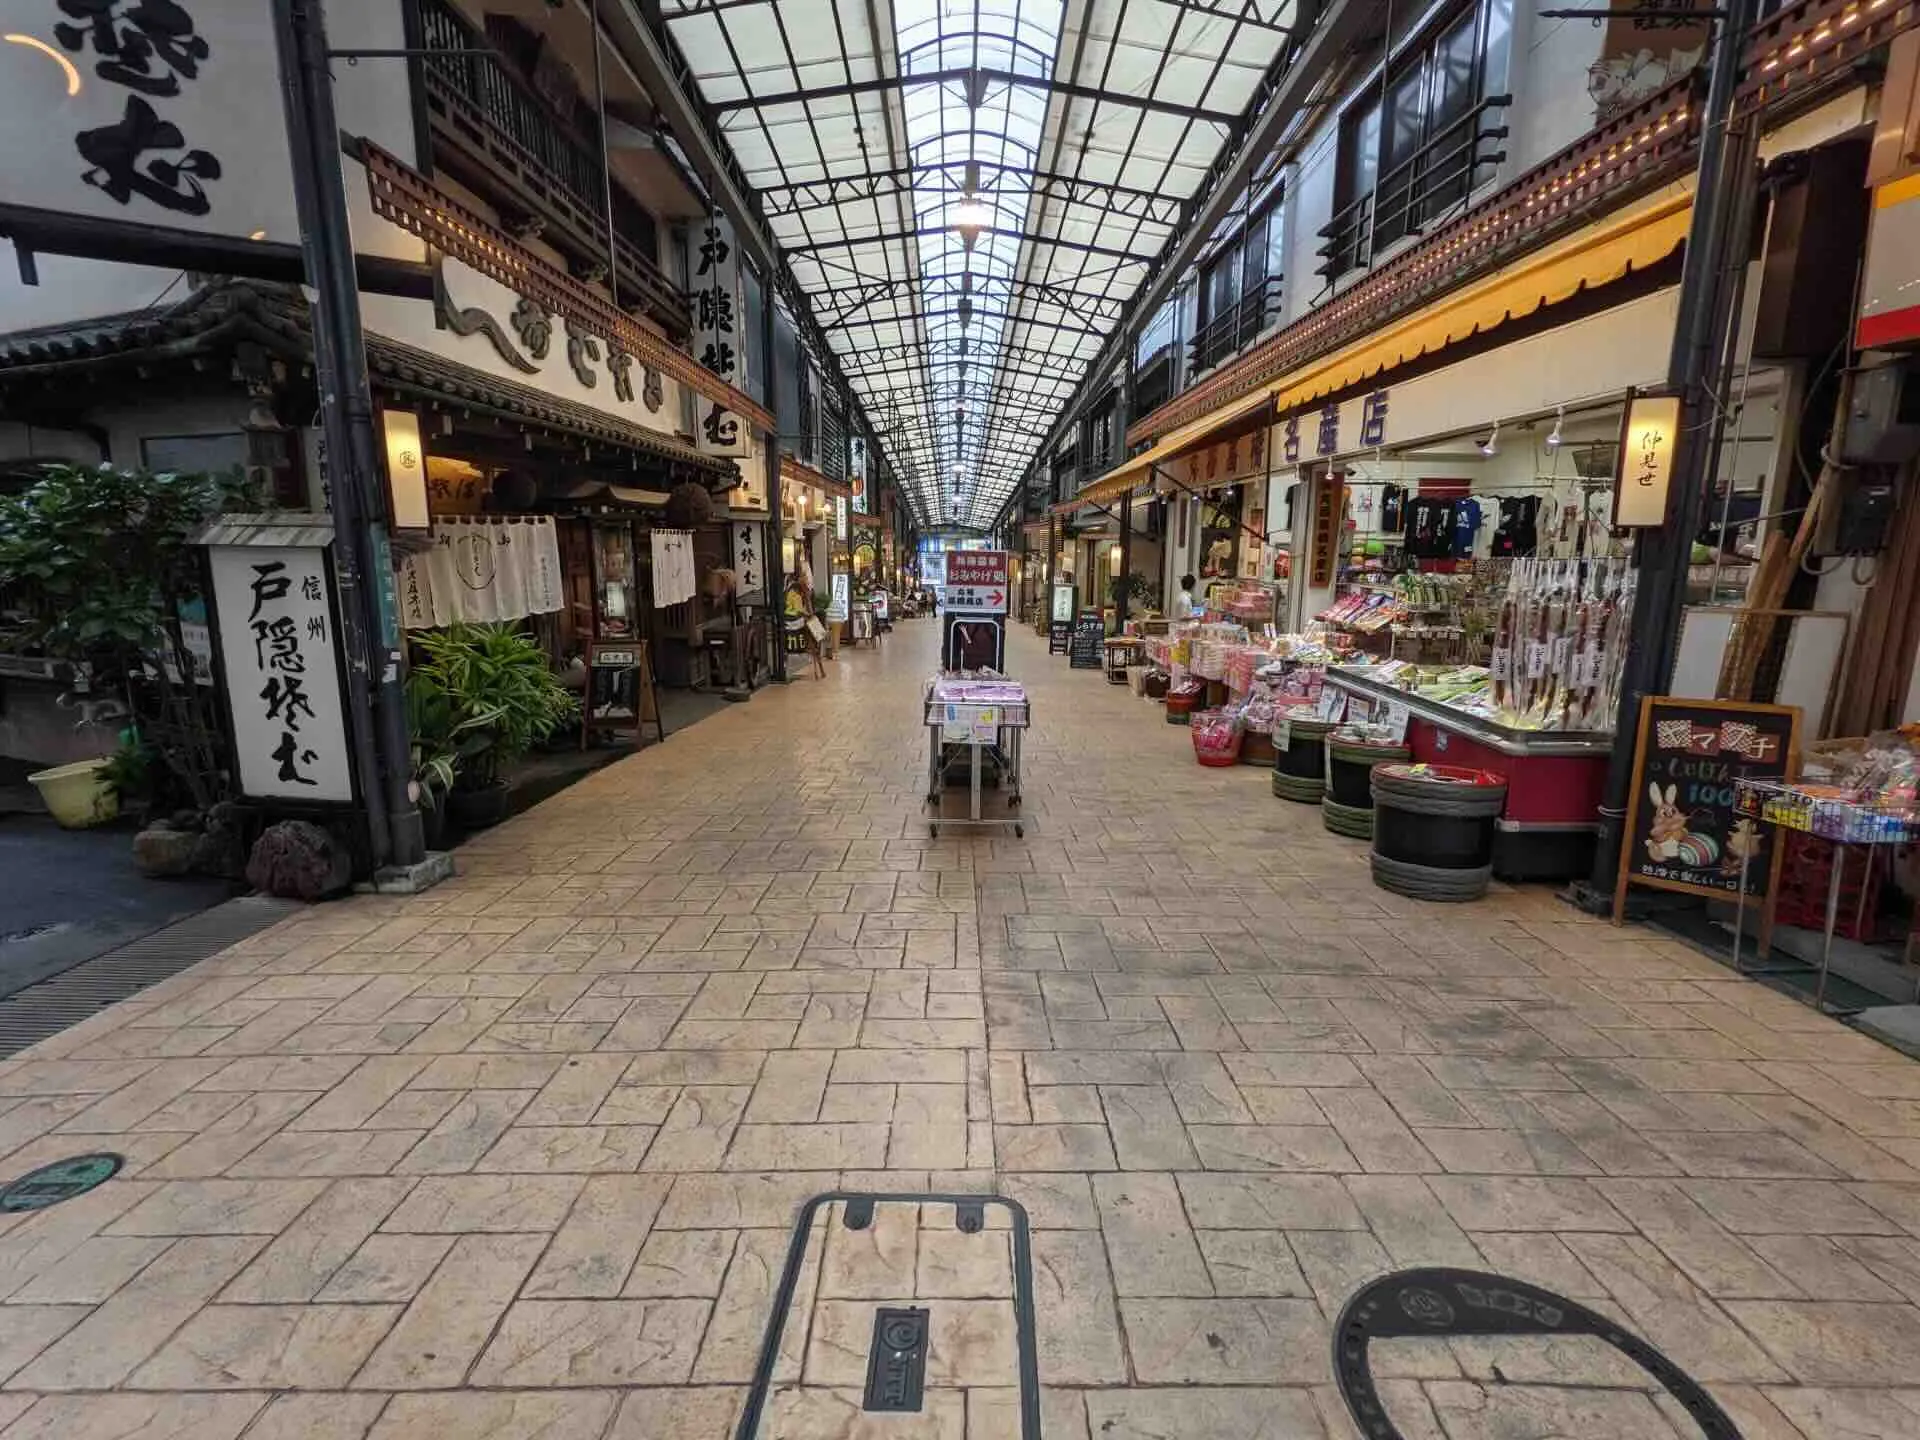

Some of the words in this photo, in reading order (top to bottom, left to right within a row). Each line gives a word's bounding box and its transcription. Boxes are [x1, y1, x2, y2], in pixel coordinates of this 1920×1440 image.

[1637, 431, 1663, 486] 仲見世
[302, 575, 326, 642] 信州
